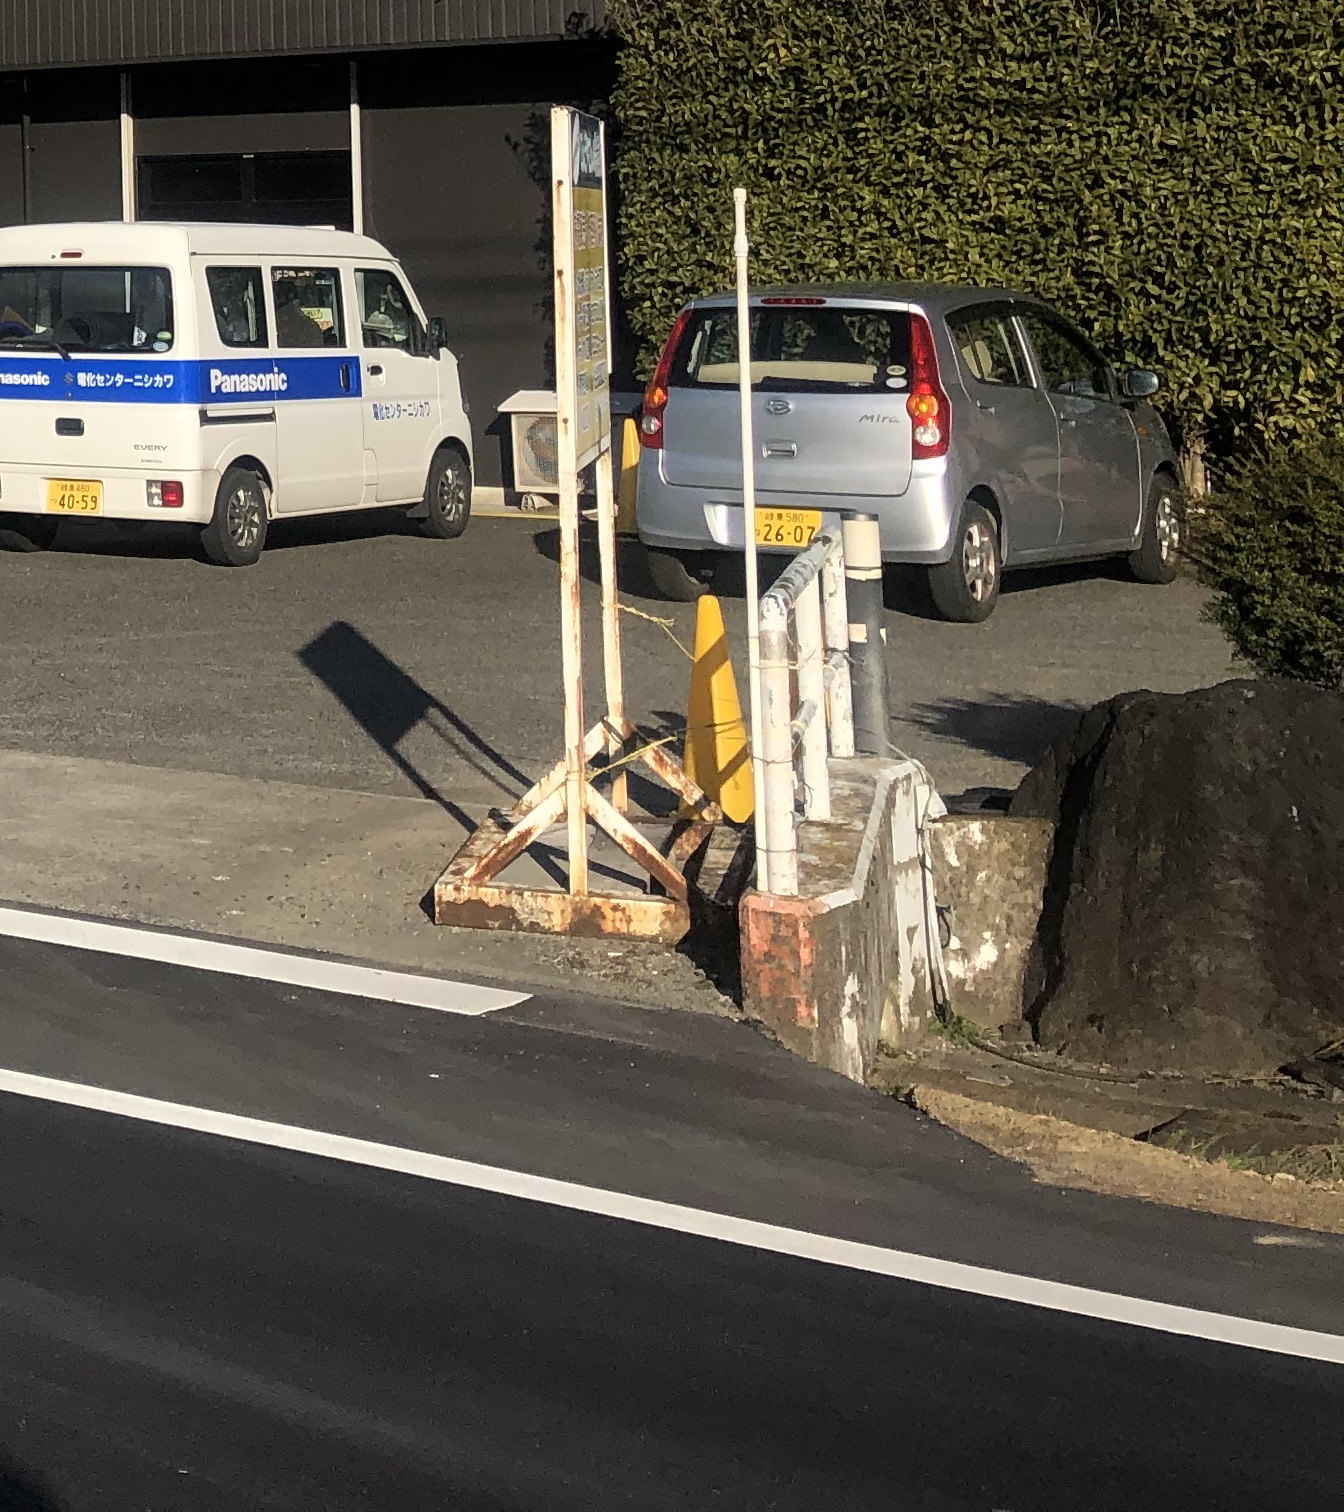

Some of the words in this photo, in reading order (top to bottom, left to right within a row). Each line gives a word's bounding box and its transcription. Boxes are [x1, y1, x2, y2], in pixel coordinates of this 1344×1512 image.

[77, 372, 174, 388] 電化センターニシカワ
[210, 367, 288, 394] Panasonic
[133, 444, 168, 452] EVERY
[58, 493, 98, 510] 40-59
[763, 523, 816, 544] 26-07
